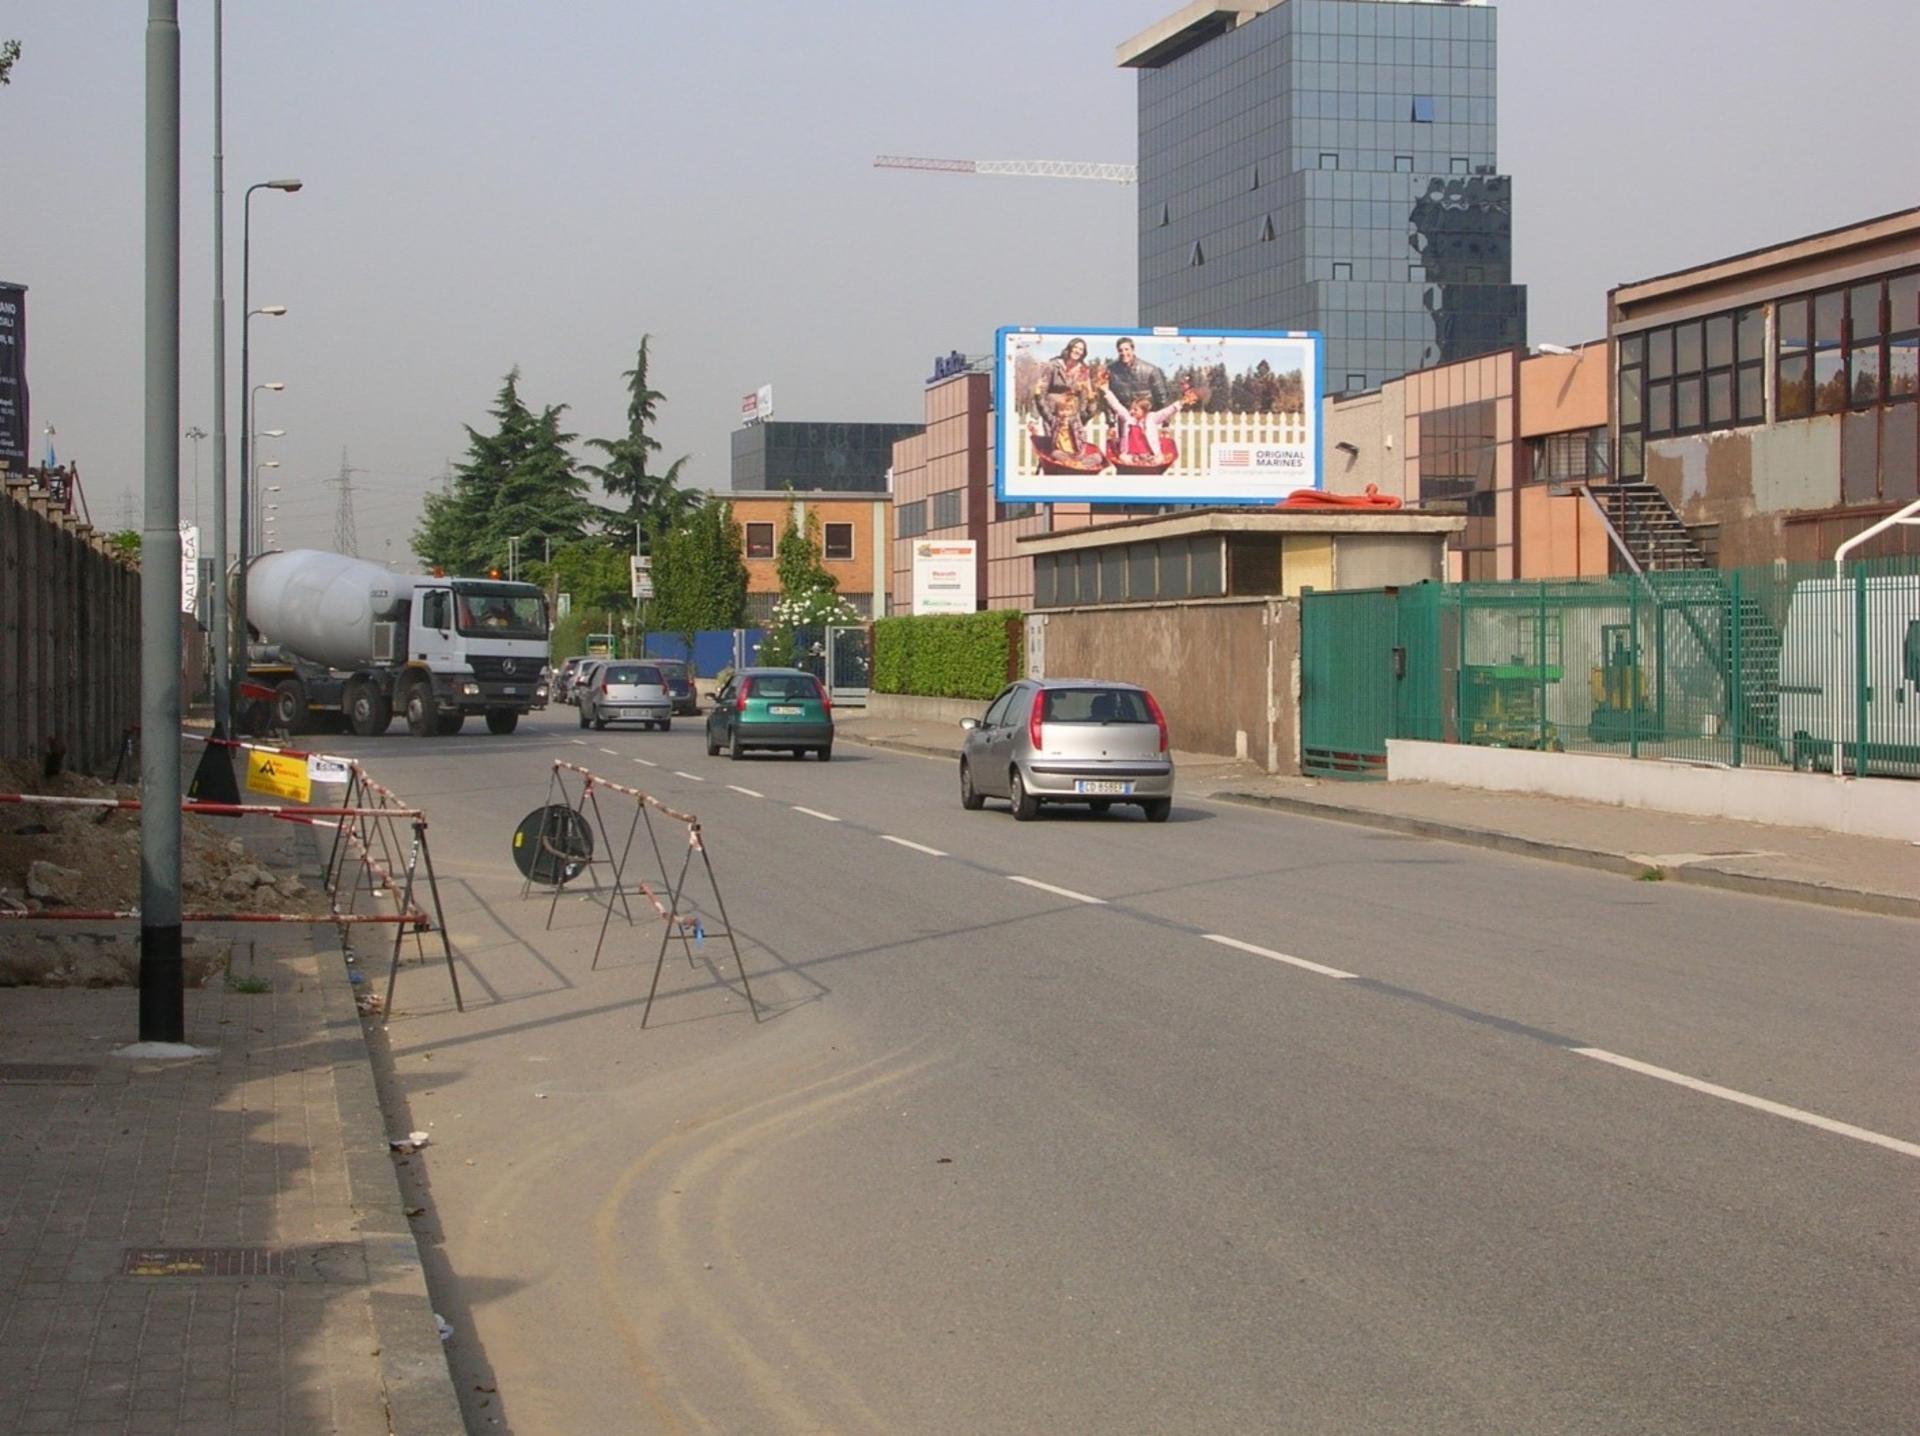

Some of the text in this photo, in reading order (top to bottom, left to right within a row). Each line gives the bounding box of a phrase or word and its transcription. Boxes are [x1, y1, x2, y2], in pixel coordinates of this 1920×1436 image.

[1256, 450, 1305, 459] ORIGINAL
[1256, 459, 1303, 467] MARINES
[185, 537, 196, 611] NAUTICA
